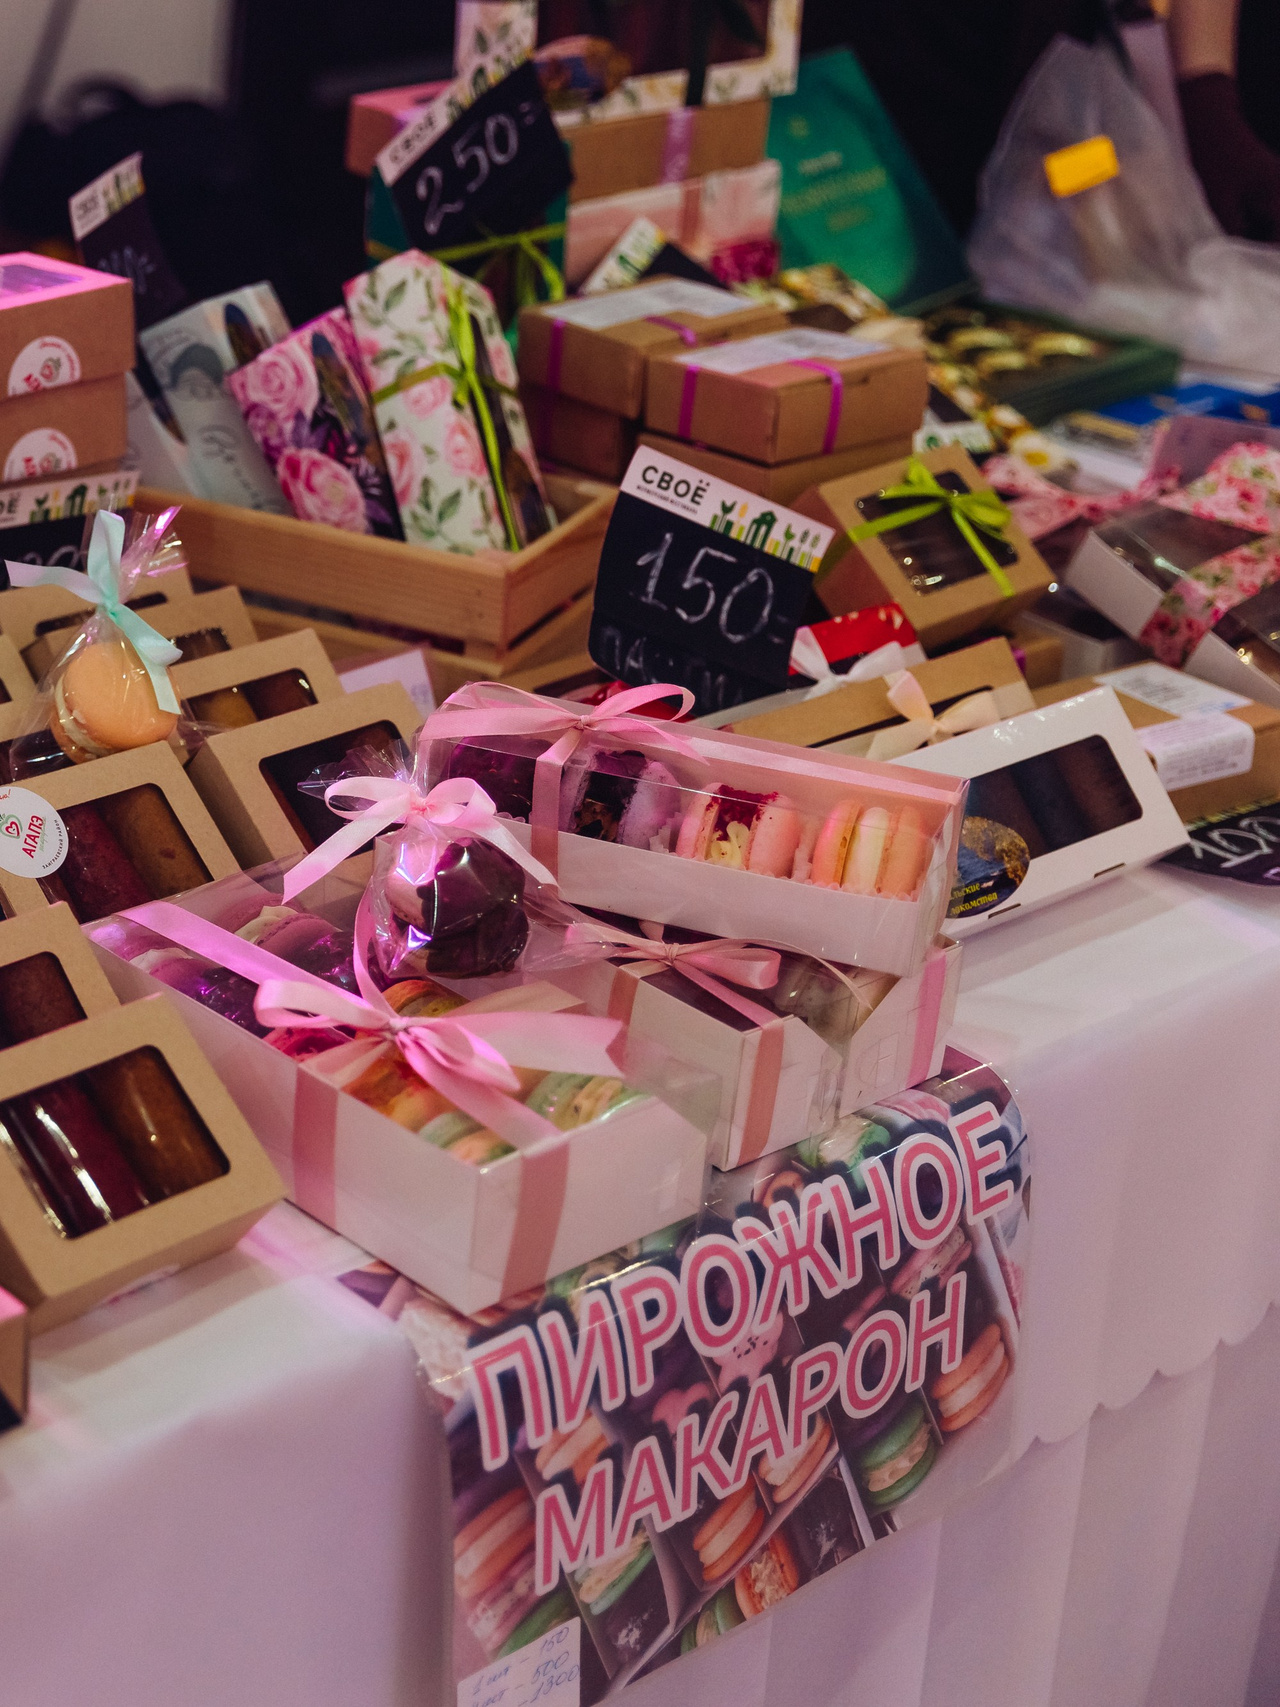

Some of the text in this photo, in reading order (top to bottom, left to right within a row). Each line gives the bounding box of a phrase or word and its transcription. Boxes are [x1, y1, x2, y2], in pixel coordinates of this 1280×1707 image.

[640, 465, 711, 506] СВОЁ
[21, 815, 45, 860] АГАПЭ
[41, 838, 65, 870] ЗАИГРАЕВСКИЙ
[464, 1101, 1017, 1470] ПИРОЖНОЕ
[534, 1271, 968, 1597] МАКАРОН
[531, 1651, 569, 1684] 500
